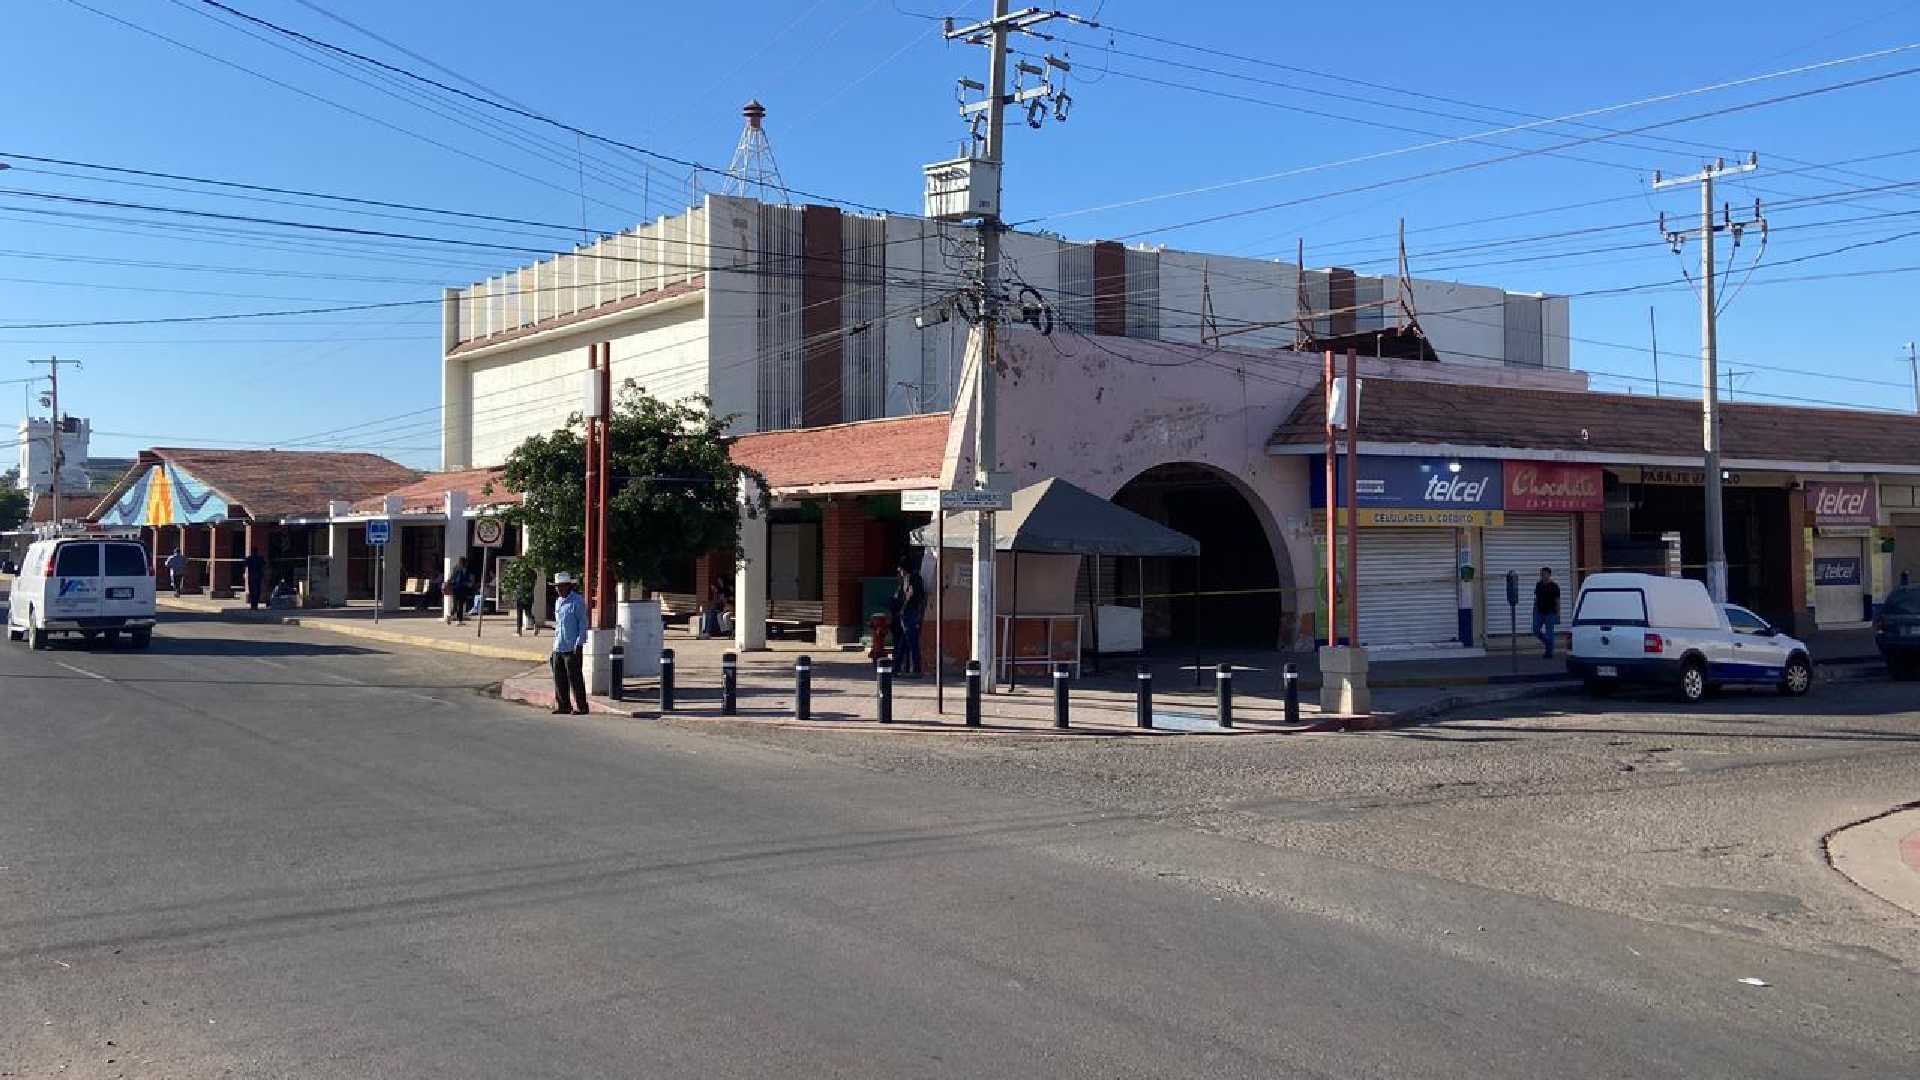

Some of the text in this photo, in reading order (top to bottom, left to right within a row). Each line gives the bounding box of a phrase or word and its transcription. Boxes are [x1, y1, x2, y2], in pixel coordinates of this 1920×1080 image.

[1424, 474, 1489, 502] telcel
[1641, 472, 1690, 482] PASAJE
[1816, 487, 1868, 514] telcel
[1825, 561, 1855, 579] telcel
